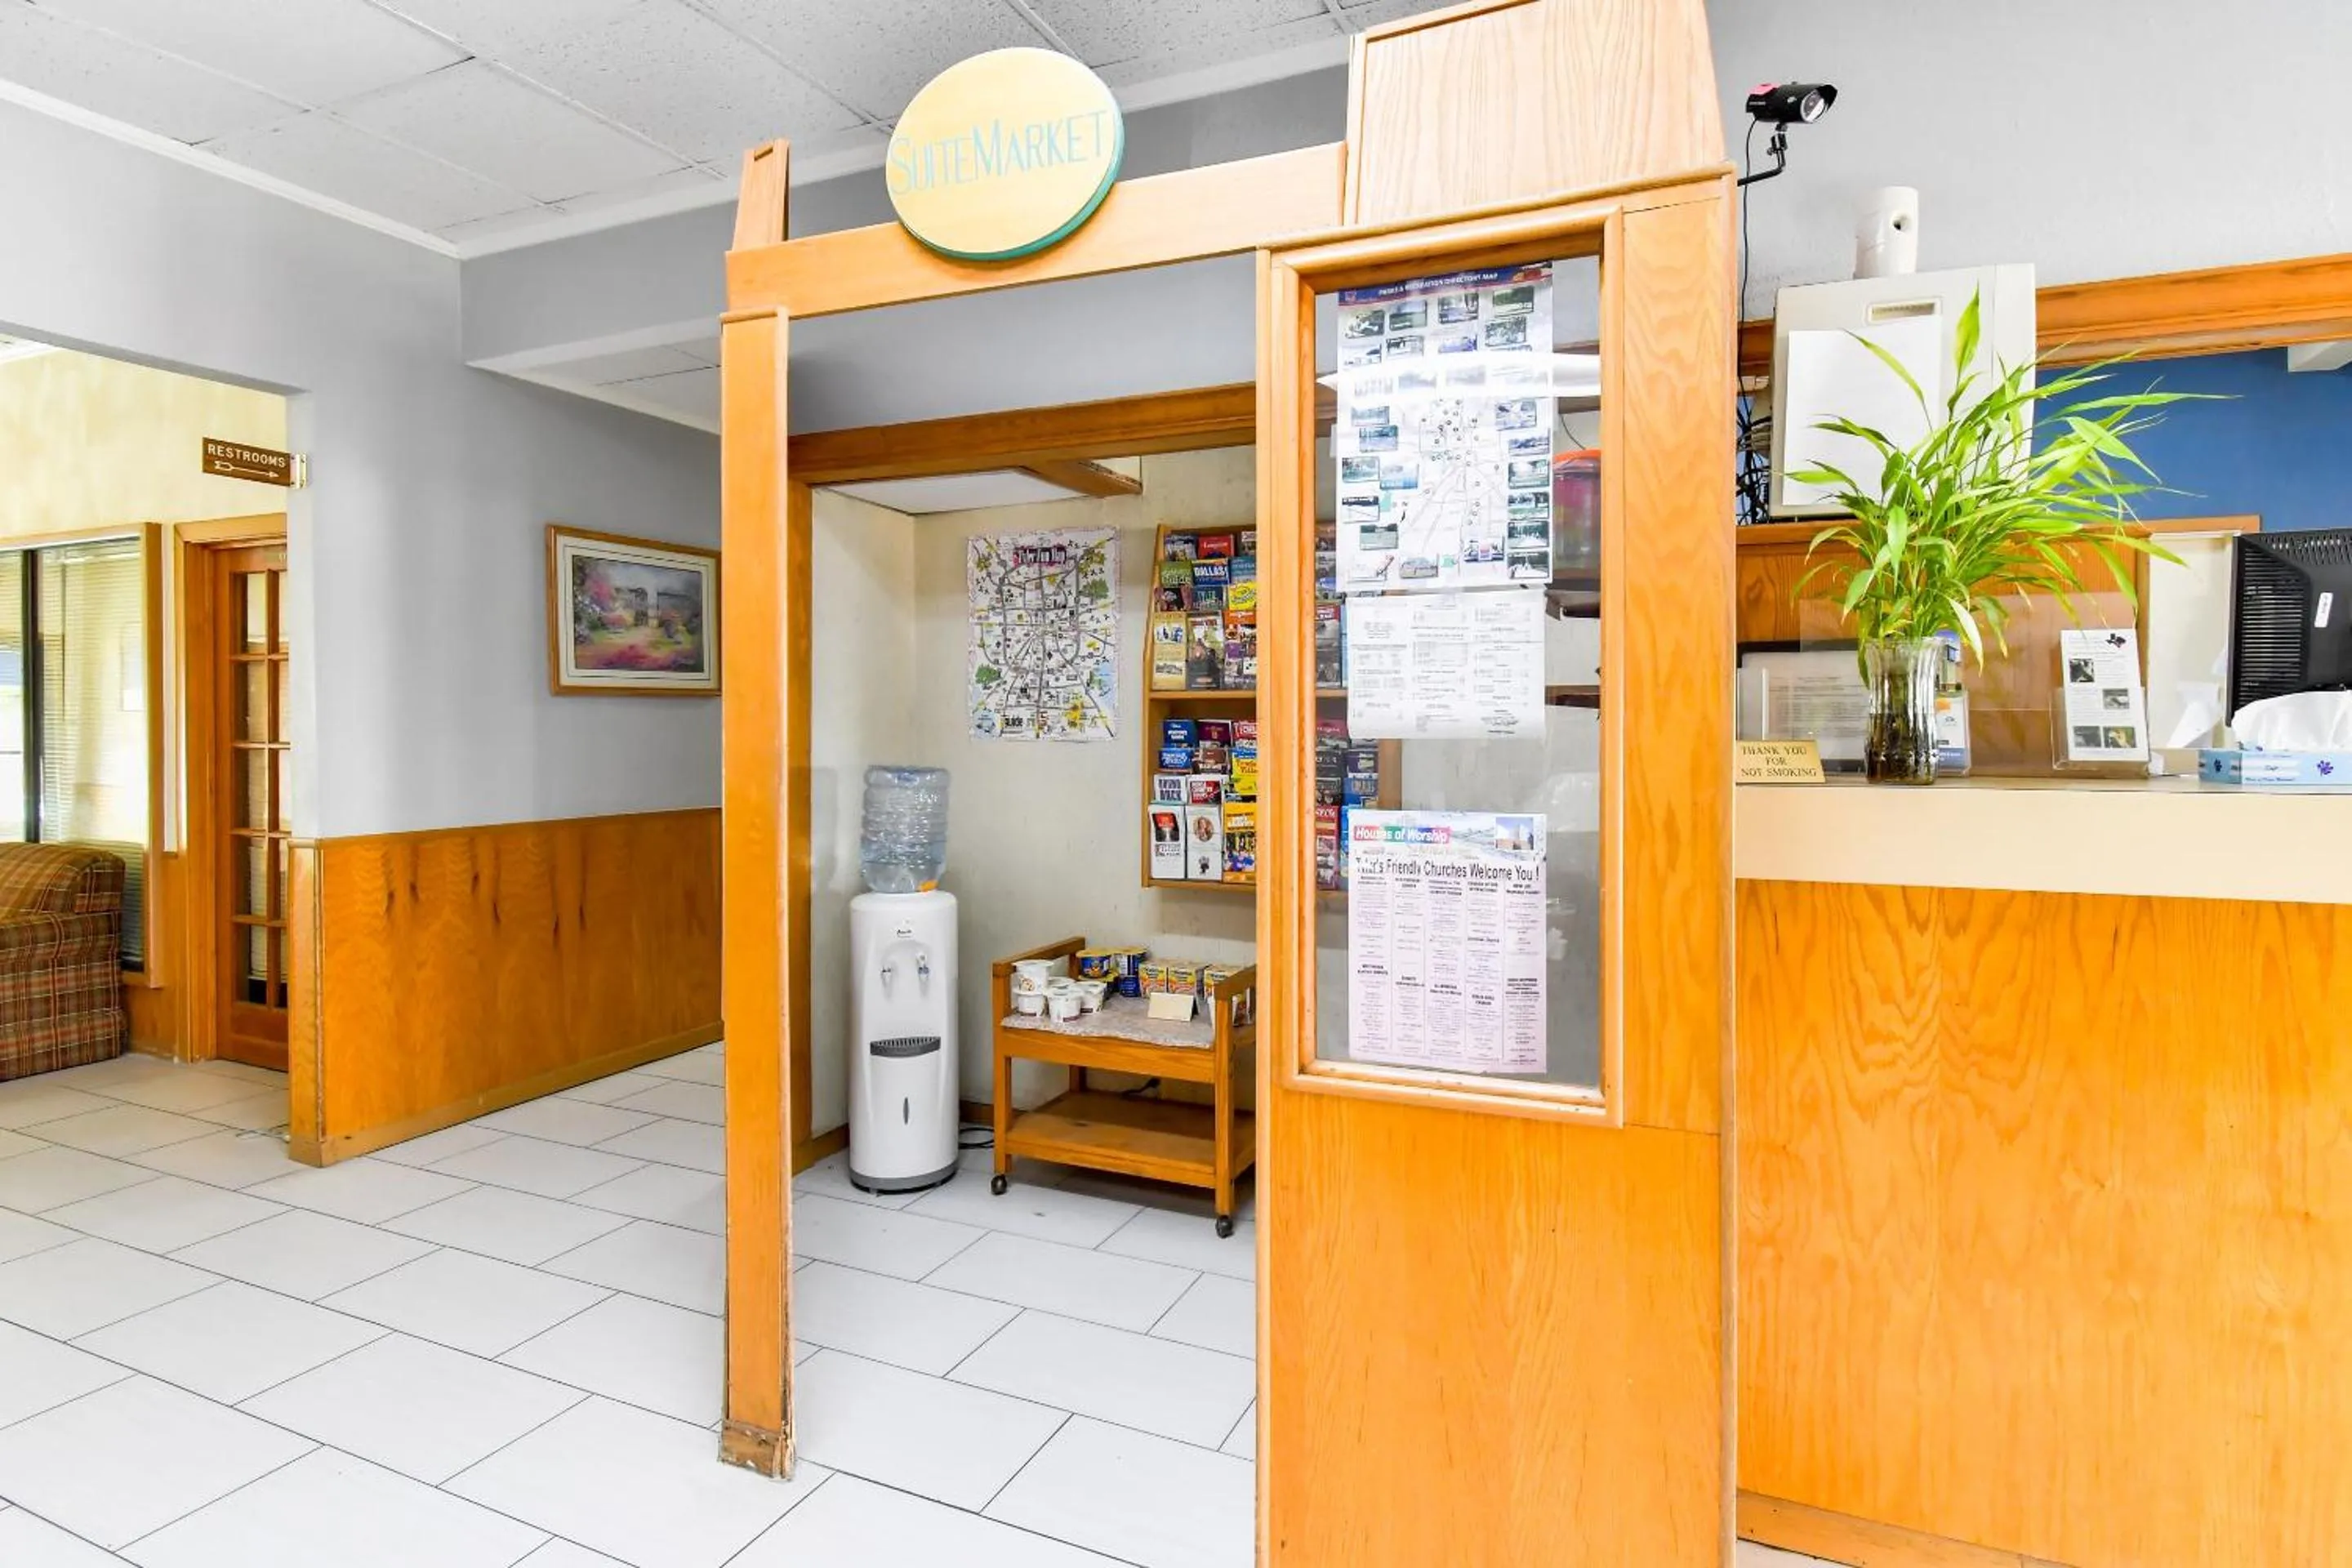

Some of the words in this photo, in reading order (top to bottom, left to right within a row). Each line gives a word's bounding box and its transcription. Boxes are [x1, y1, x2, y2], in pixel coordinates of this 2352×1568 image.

[1482, 272, 1499, 280] MAP
[207, 443, 286, 468] RESTROOMS
[1742, 746, 1780, 755] THANK
[1784, 745, 1807, 755] YOU
[1766, 756, 1787, 766] FOR
[1740, 768, 1763, 777] NOT
[1766, 768, 1817, 777] SMOKING
[1355, 827, 1392, 840] Houses
[1394, 827, 1405, 840] of
[1407, 828, 1448, 844] Worship
[1386, 858, 1421, 875] Friendly
[1423, 860, 1468, 878] Churches
[1469, 862, 1512, 881] Welcome
